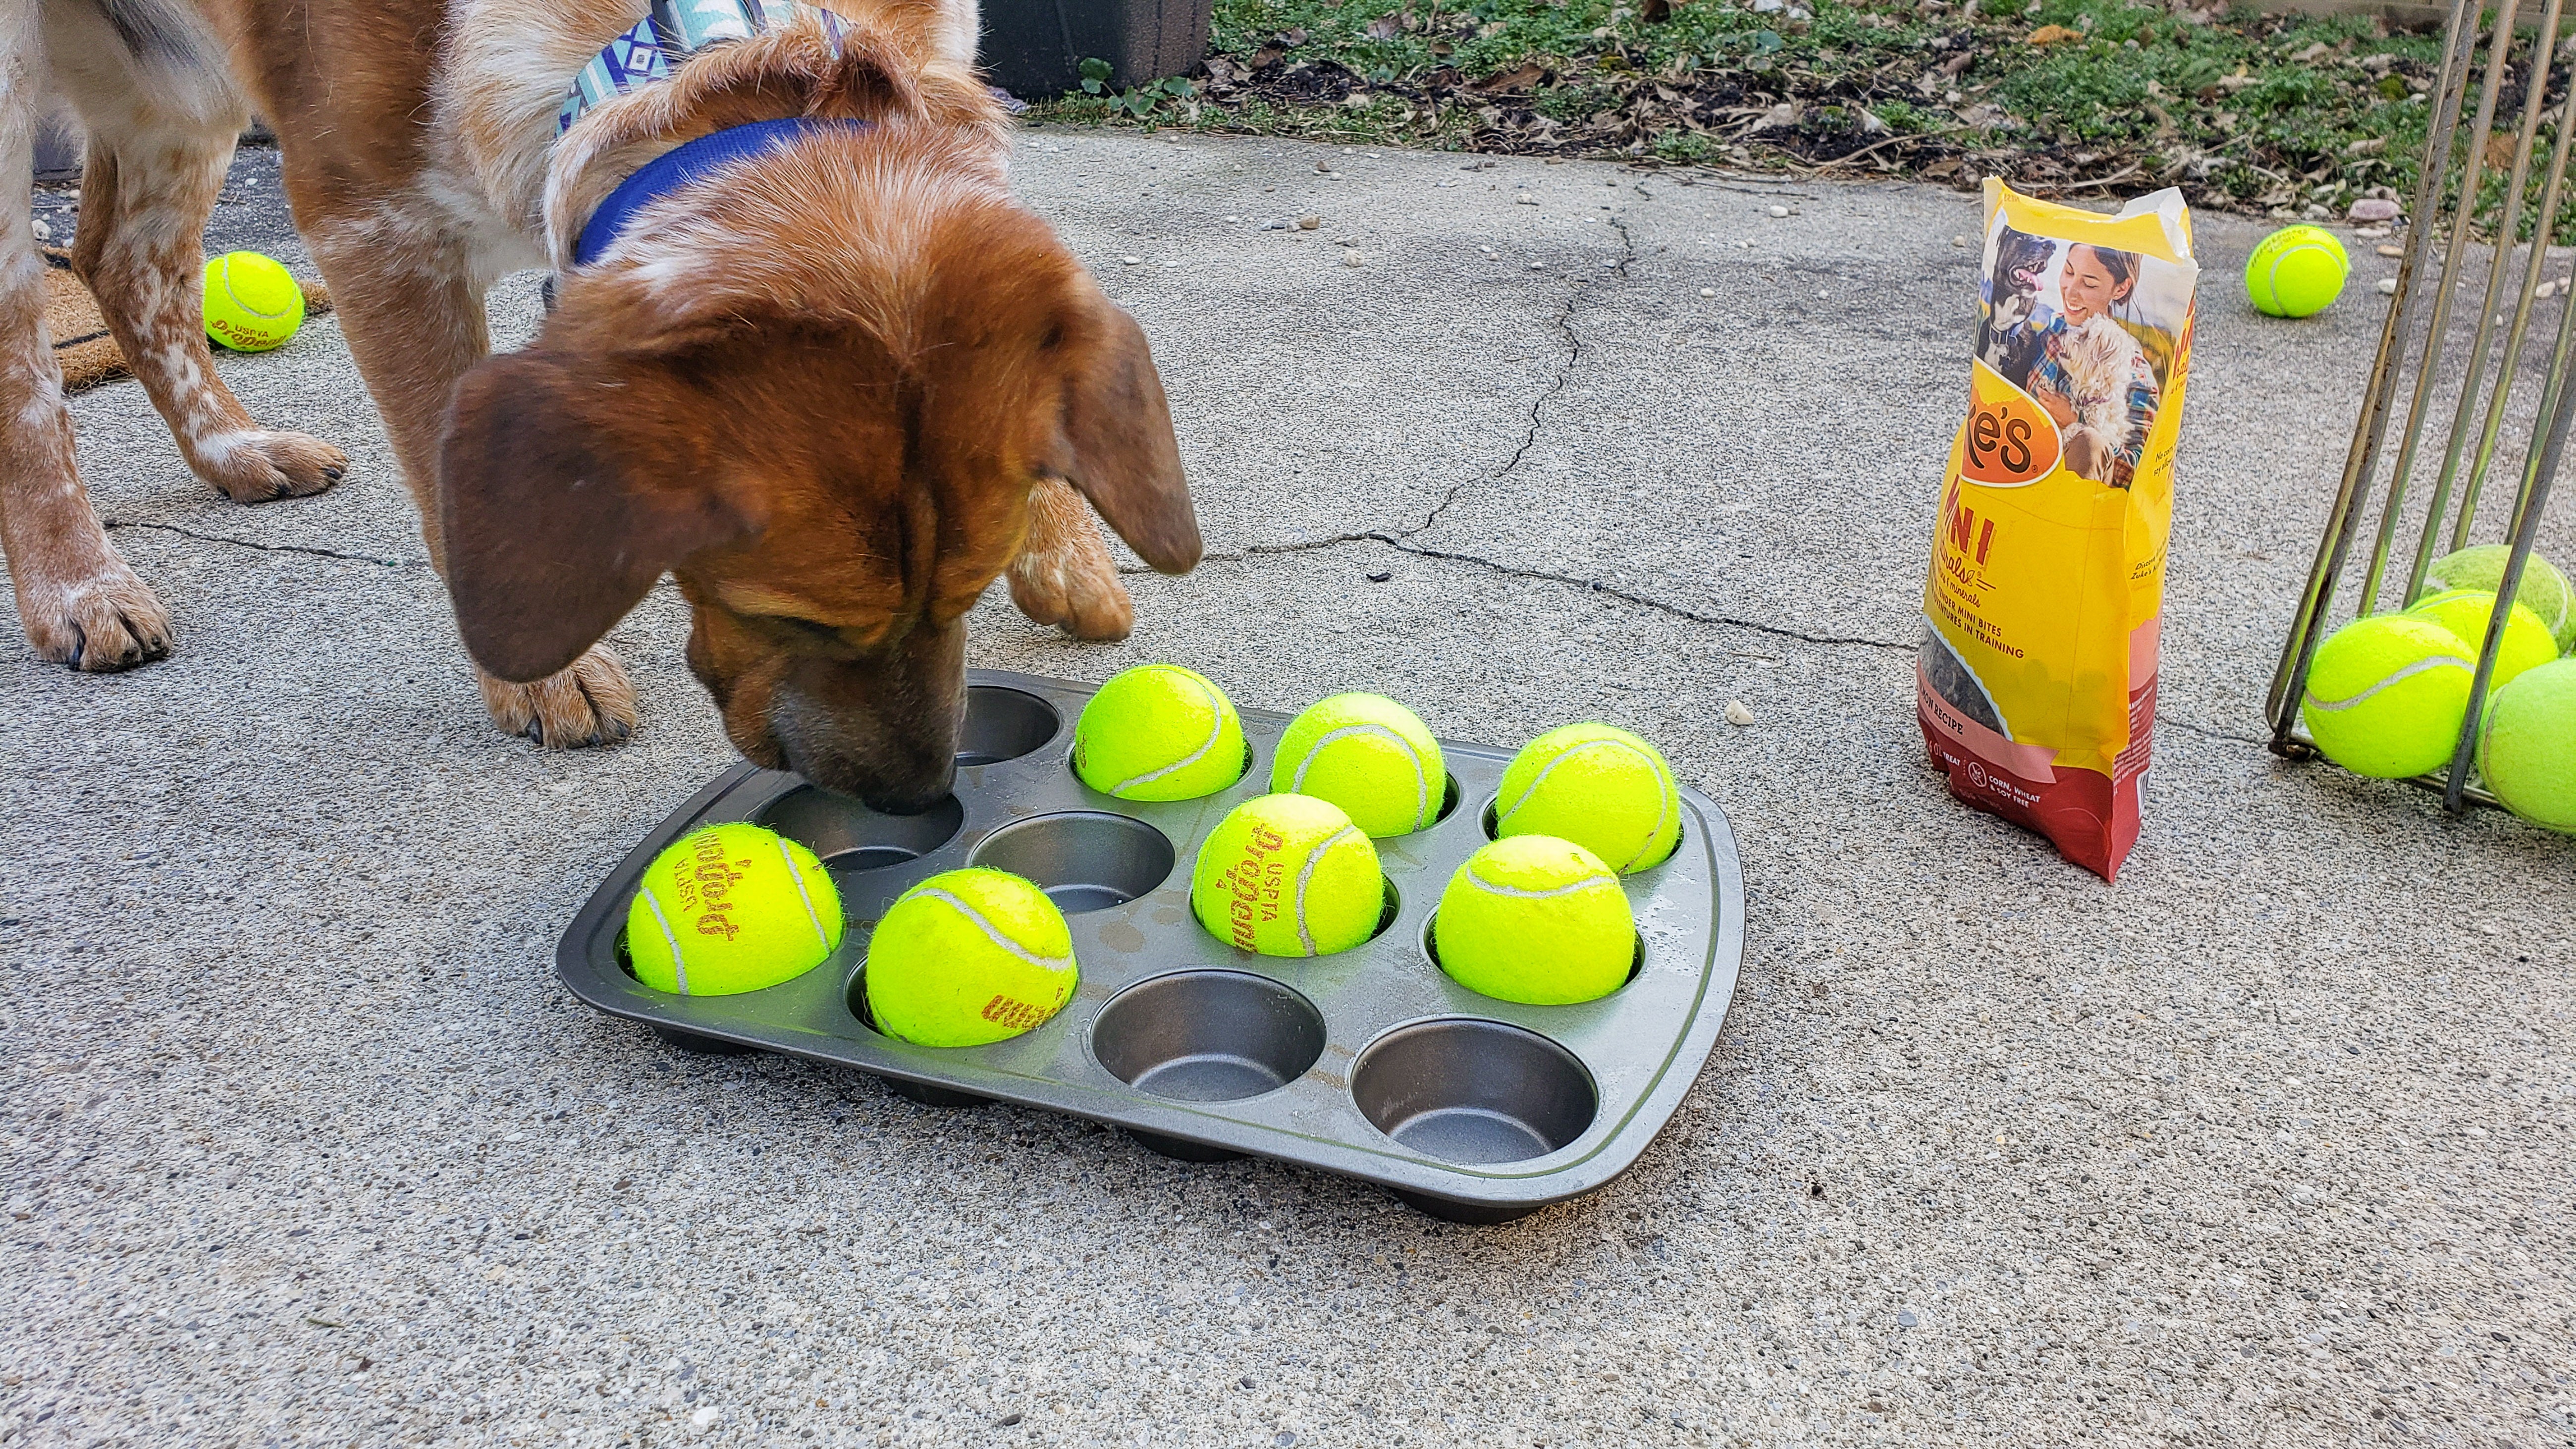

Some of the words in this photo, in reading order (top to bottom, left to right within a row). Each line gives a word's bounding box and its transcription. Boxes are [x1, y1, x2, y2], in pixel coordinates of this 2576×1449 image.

[1950, 582, 1981, 608] minerals
[1957, 605, 1976, 624] MINI
[1978, 618, 2001, 637] BITES
[1964, 623, 1973, 635] IN
[1976, 629, 2024, 658] TRAINING
[1934, 703, 1964, 735] RECIPE
[1989, 775, 2012, 792] CORN,
[2014, 786, 2040, 803] WHEAT
[1997, 788, 2011, 799] SOY
[2013, 795, 2029, 808] FREE
[674, 858, 698, 912] USPTA
[1261, 863, 1284, 921] USPTA
